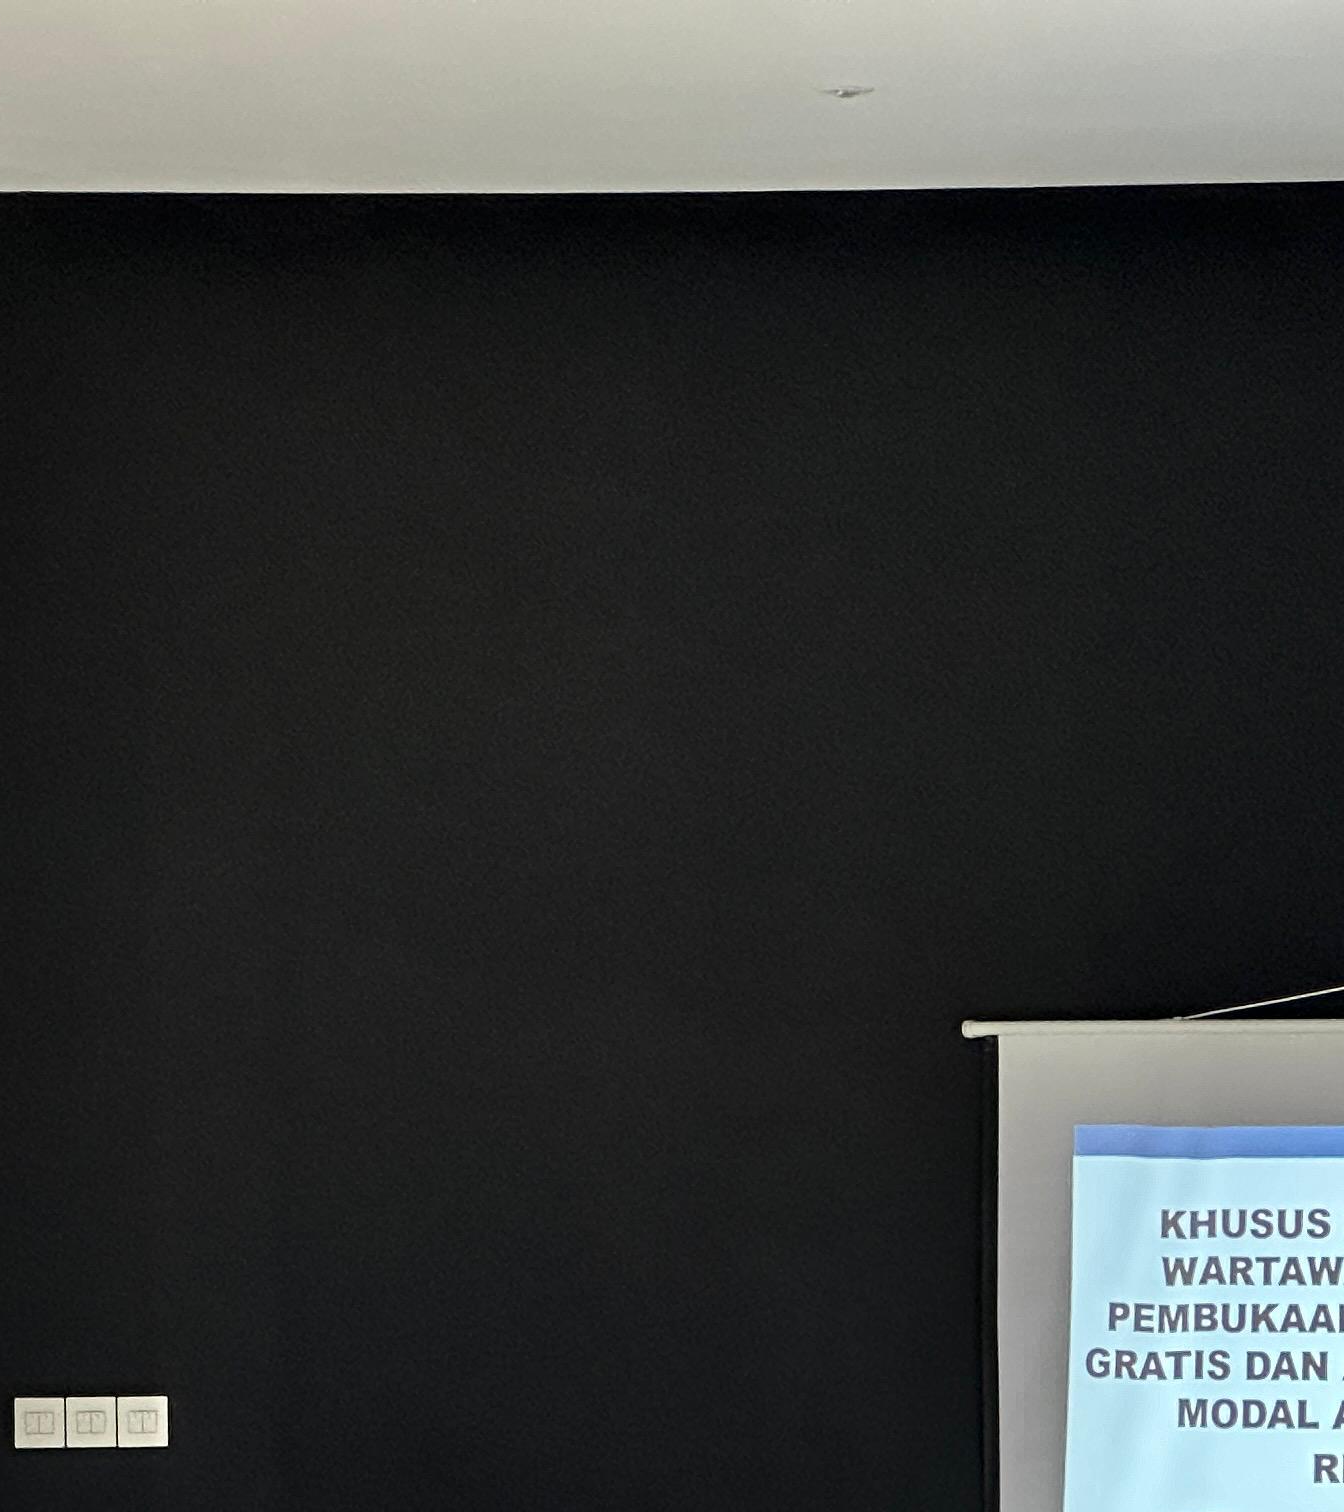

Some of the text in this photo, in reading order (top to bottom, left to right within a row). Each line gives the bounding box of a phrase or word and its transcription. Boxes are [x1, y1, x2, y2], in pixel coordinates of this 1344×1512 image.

[1160, 1208, 1331, 1240] KHUSUS
[1085, 1347, 1231, 1381] GRATIS
[1246, 1350, 1329, 1381] DAN
[1177, 1398, 1320, 1430] MODAL
